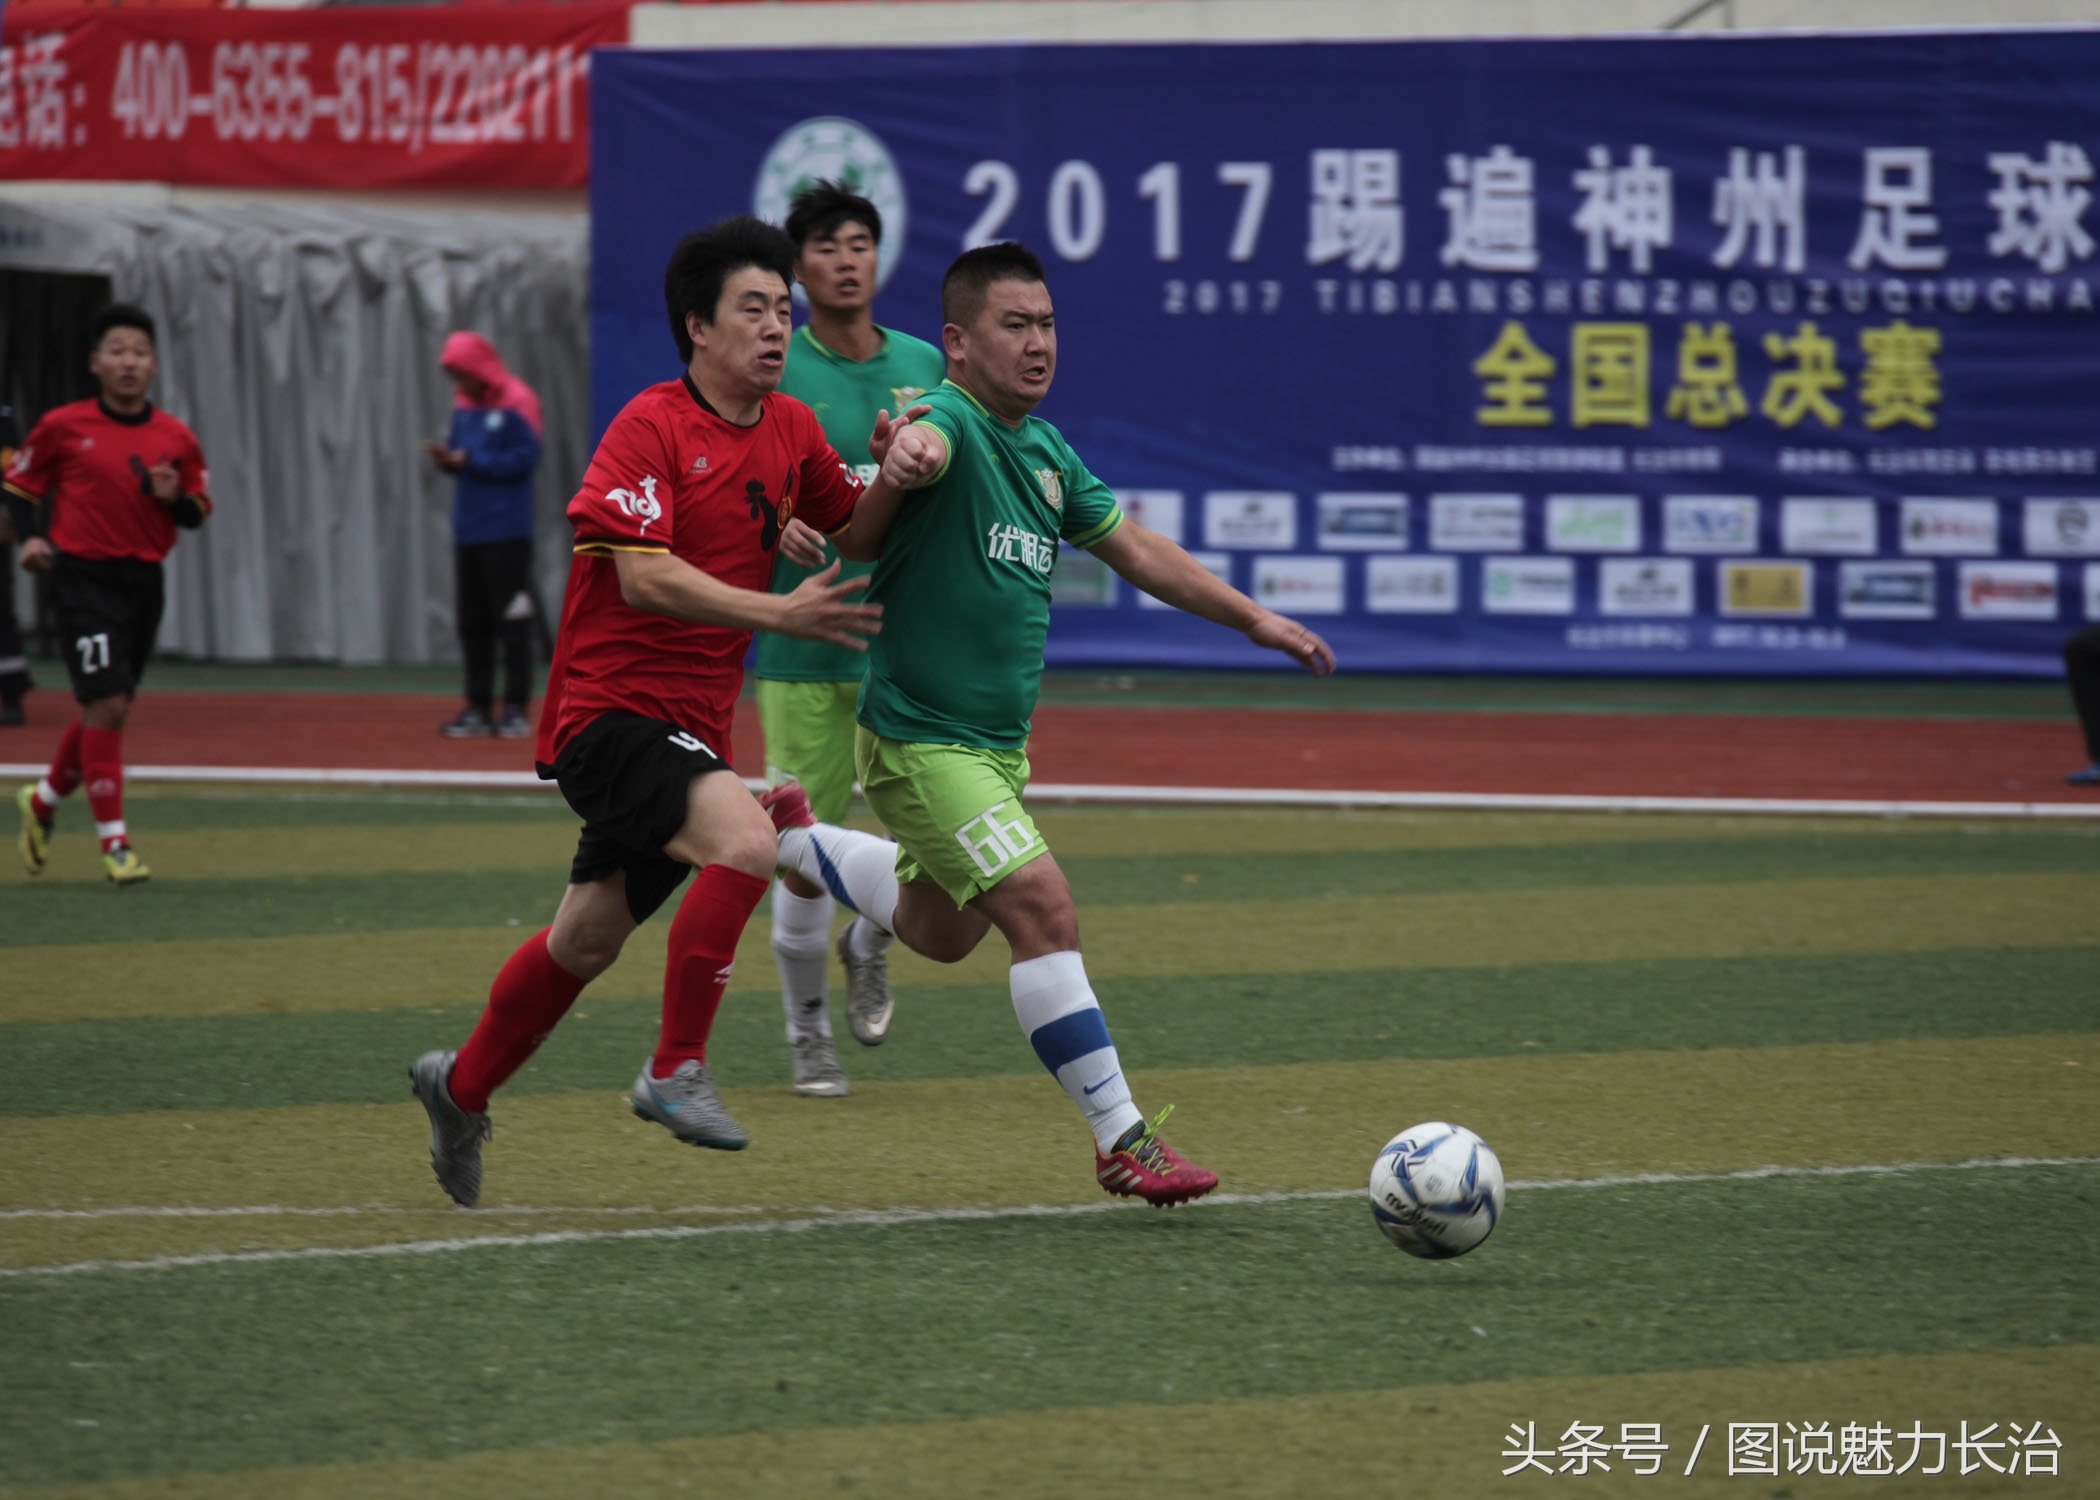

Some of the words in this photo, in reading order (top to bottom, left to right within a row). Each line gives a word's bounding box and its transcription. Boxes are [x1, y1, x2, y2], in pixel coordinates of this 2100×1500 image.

[1164, 280, 1280, 313] 2017
[1474, 320, 1942, 428] 全国总决赛
[955, 802, 1034, 877] 66
